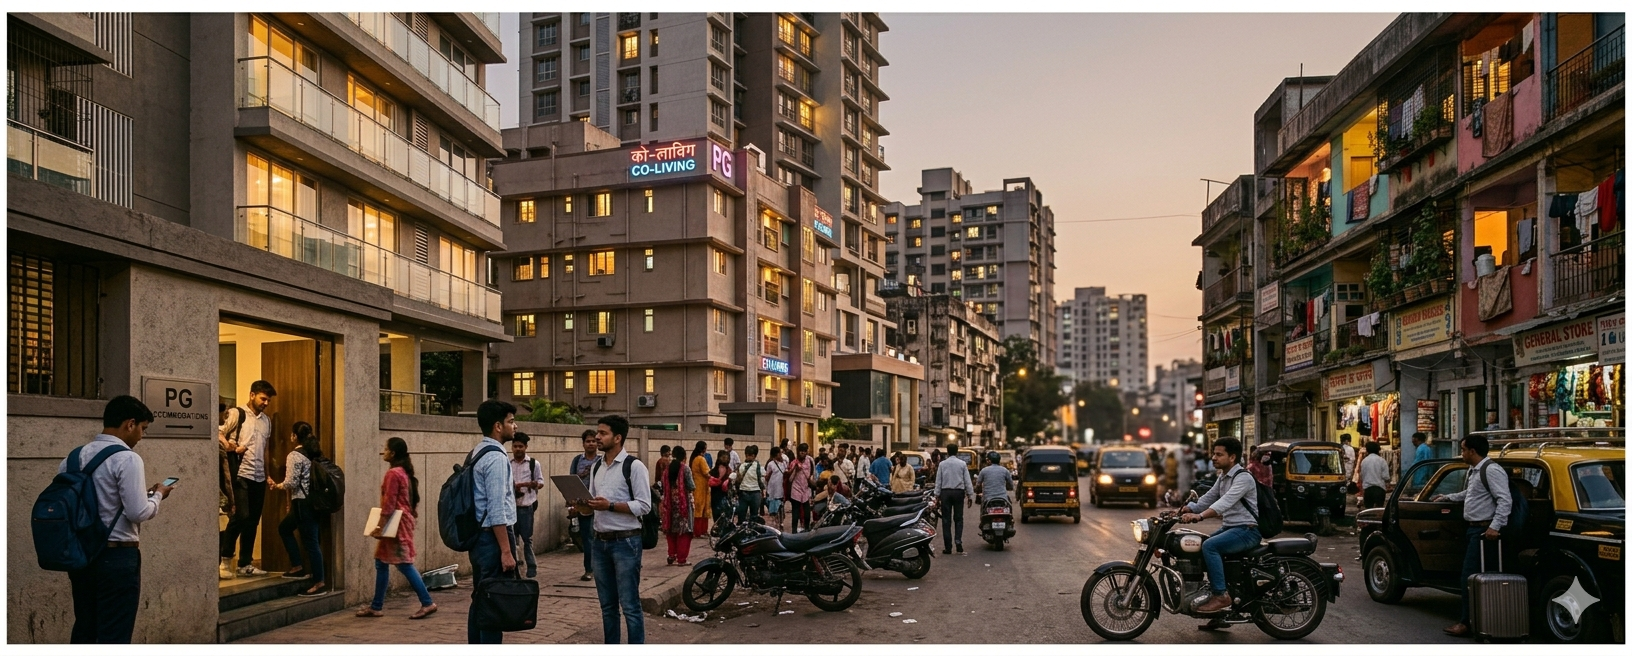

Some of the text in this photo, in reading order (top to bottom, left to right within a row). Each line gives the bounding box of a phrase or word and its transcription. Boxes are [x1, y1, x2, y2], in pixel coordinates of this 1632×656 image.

[631, 159, 696, 176] CO-LIVING
[712, 144, 732, 178] PG
[1563, 321, 1594, 341] STORE
[165, 387, 193, 409] PG
